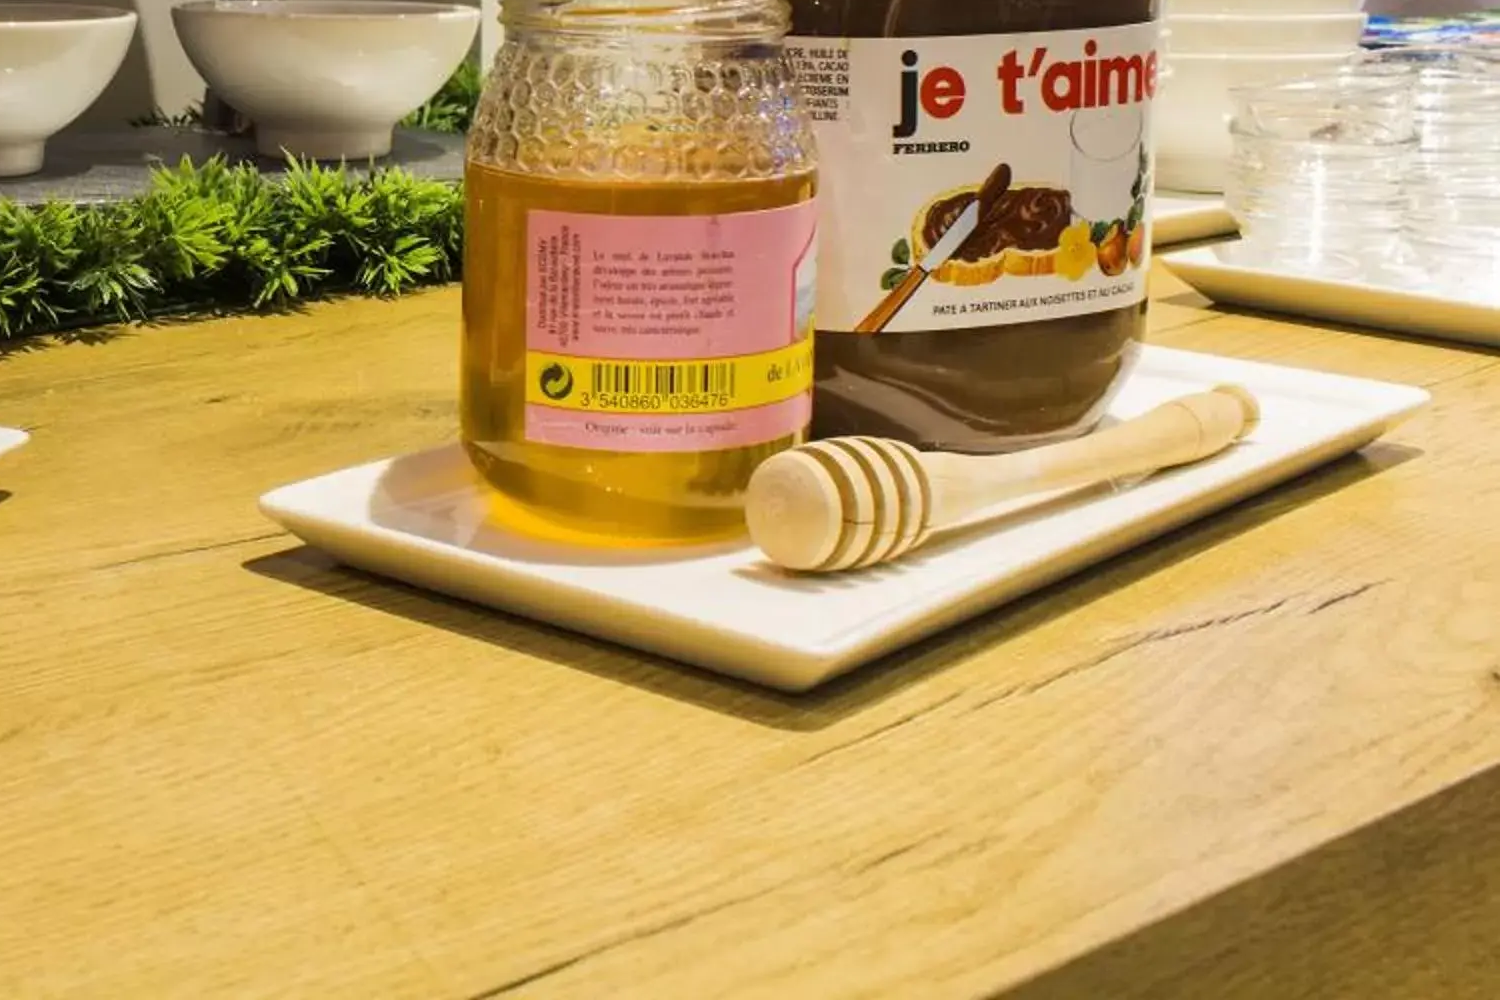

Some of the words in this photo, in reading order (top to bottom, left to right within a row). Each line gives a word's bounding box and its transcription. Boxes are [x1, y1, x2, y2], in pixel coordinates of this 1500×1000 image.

[819, 60, 849, 72] CACAO
[893, 50, 966, 138] je
[893, 140, 971, 155] FERRERO
[932, 304, 957, 316] PATE
[969, 299, 1018, 313] TARTINER
[1018, 298, 1038, 309] AUX
[1039, 290, 1086, 306] NOISETTES
[1087, 288, 1098, 301] ET
[580, 392, 591, 407] 3
[599, 393, 661, 410] 540860
